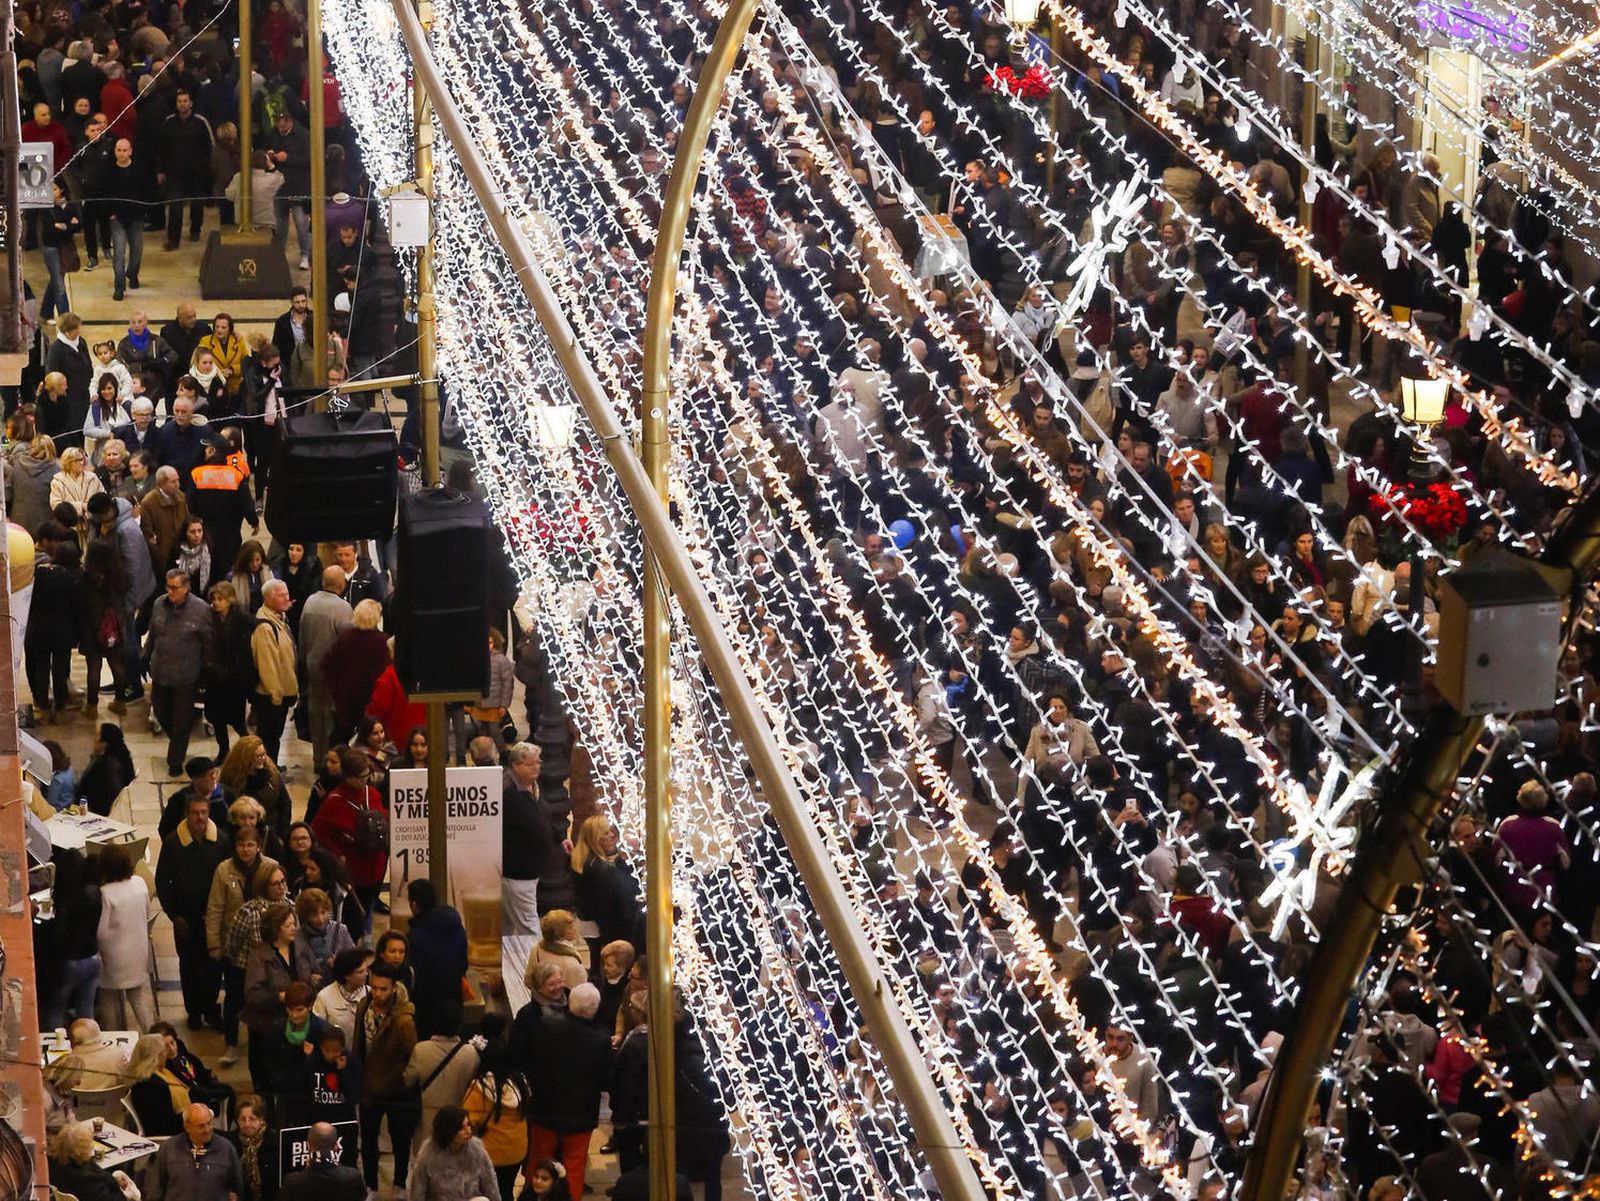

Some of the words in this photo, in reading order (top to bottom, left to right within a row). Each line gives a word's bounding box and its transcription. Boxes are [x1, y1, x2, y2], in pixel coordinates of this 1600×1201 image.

[394, 804, 404, 819] Y
[408, 801, 499, 819] MEENDAS
[292, 1136, 343, 1154] BLK
